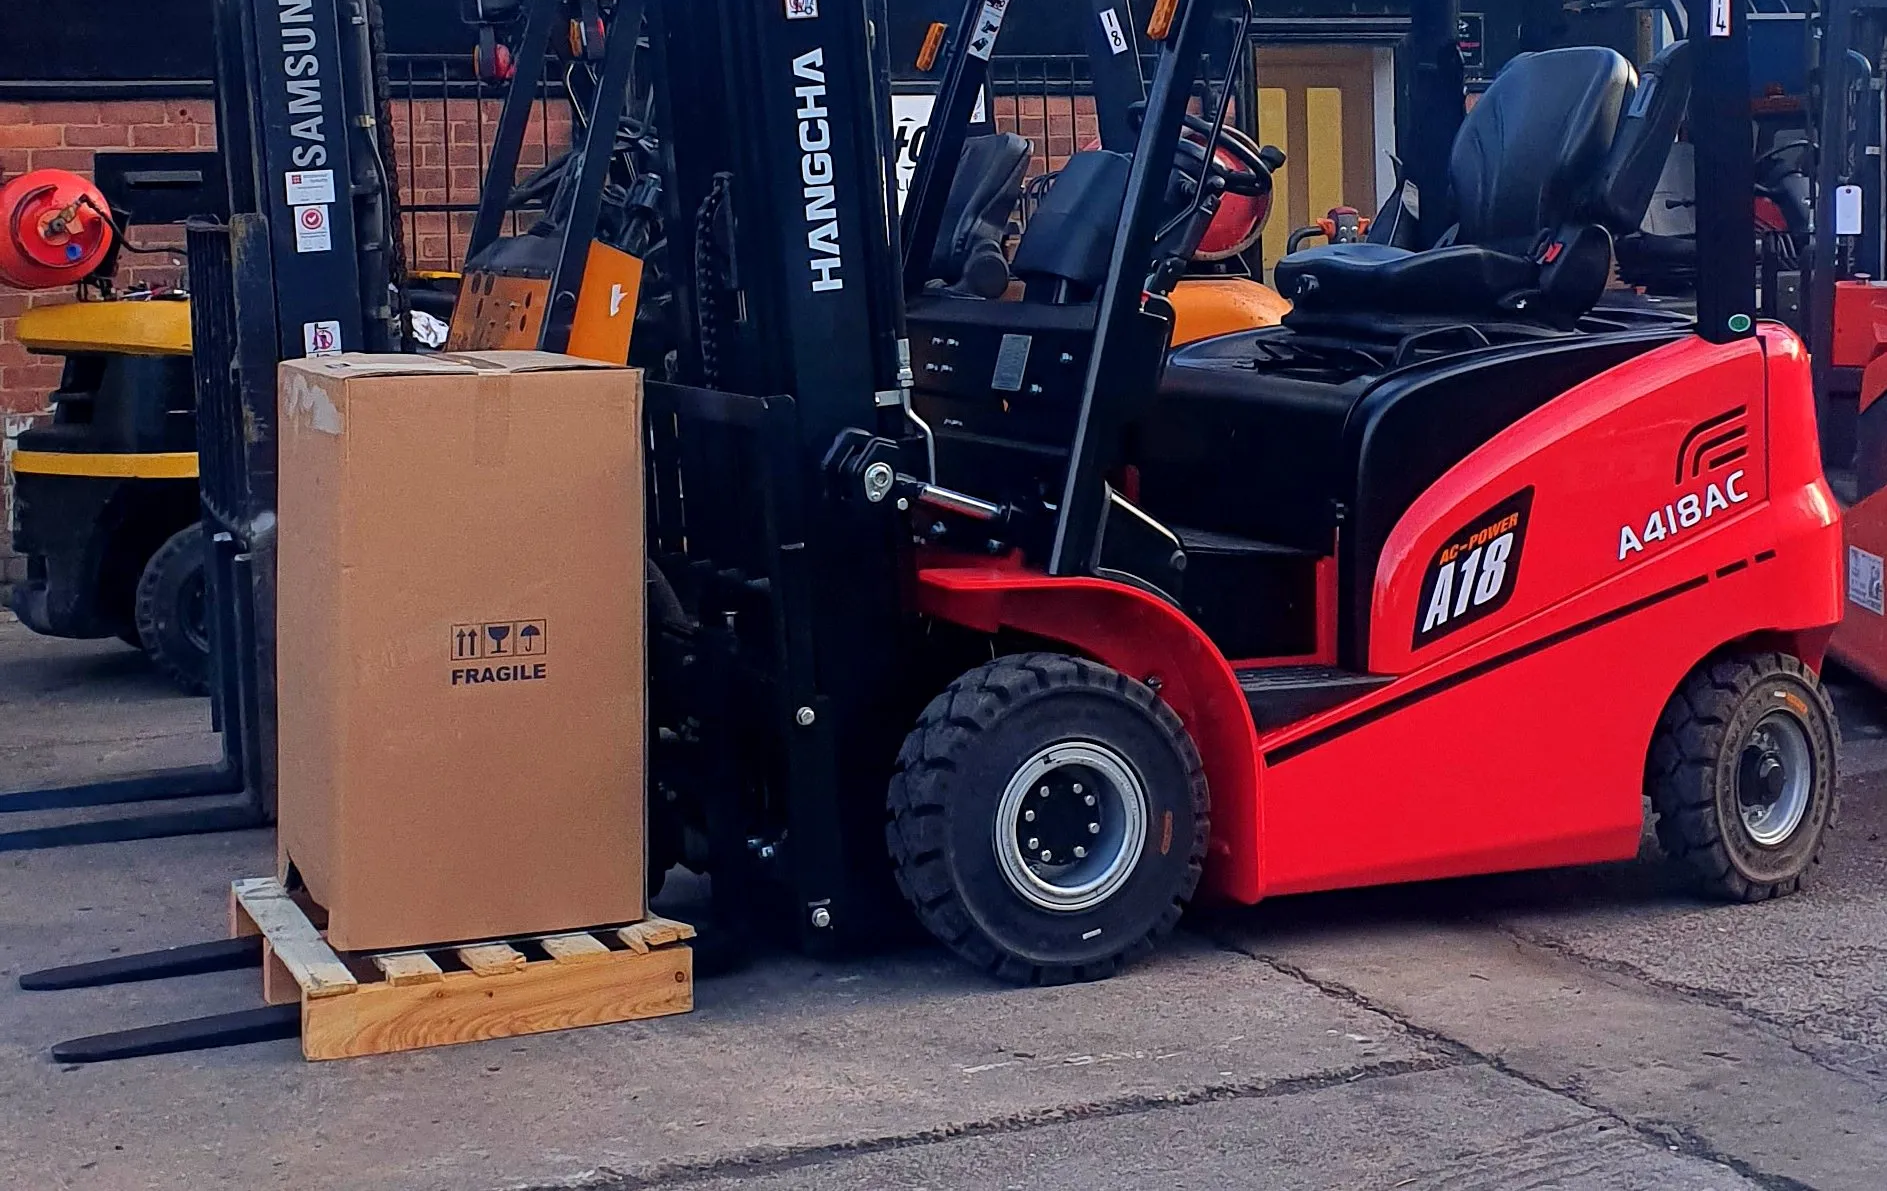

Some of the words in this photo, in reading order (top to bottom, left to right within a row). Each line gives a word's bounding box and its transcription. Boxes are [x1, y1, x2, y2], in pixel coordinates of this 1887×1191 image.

[792, 47, 843, 292] HANGCHA
[1440, 512, 1519, 566] AC-POWER
[1618, 469, 1749, 561] A418AC
[1422, 532, 1514, 633] A18
[452, 663, 546, 685] FRAGILE
